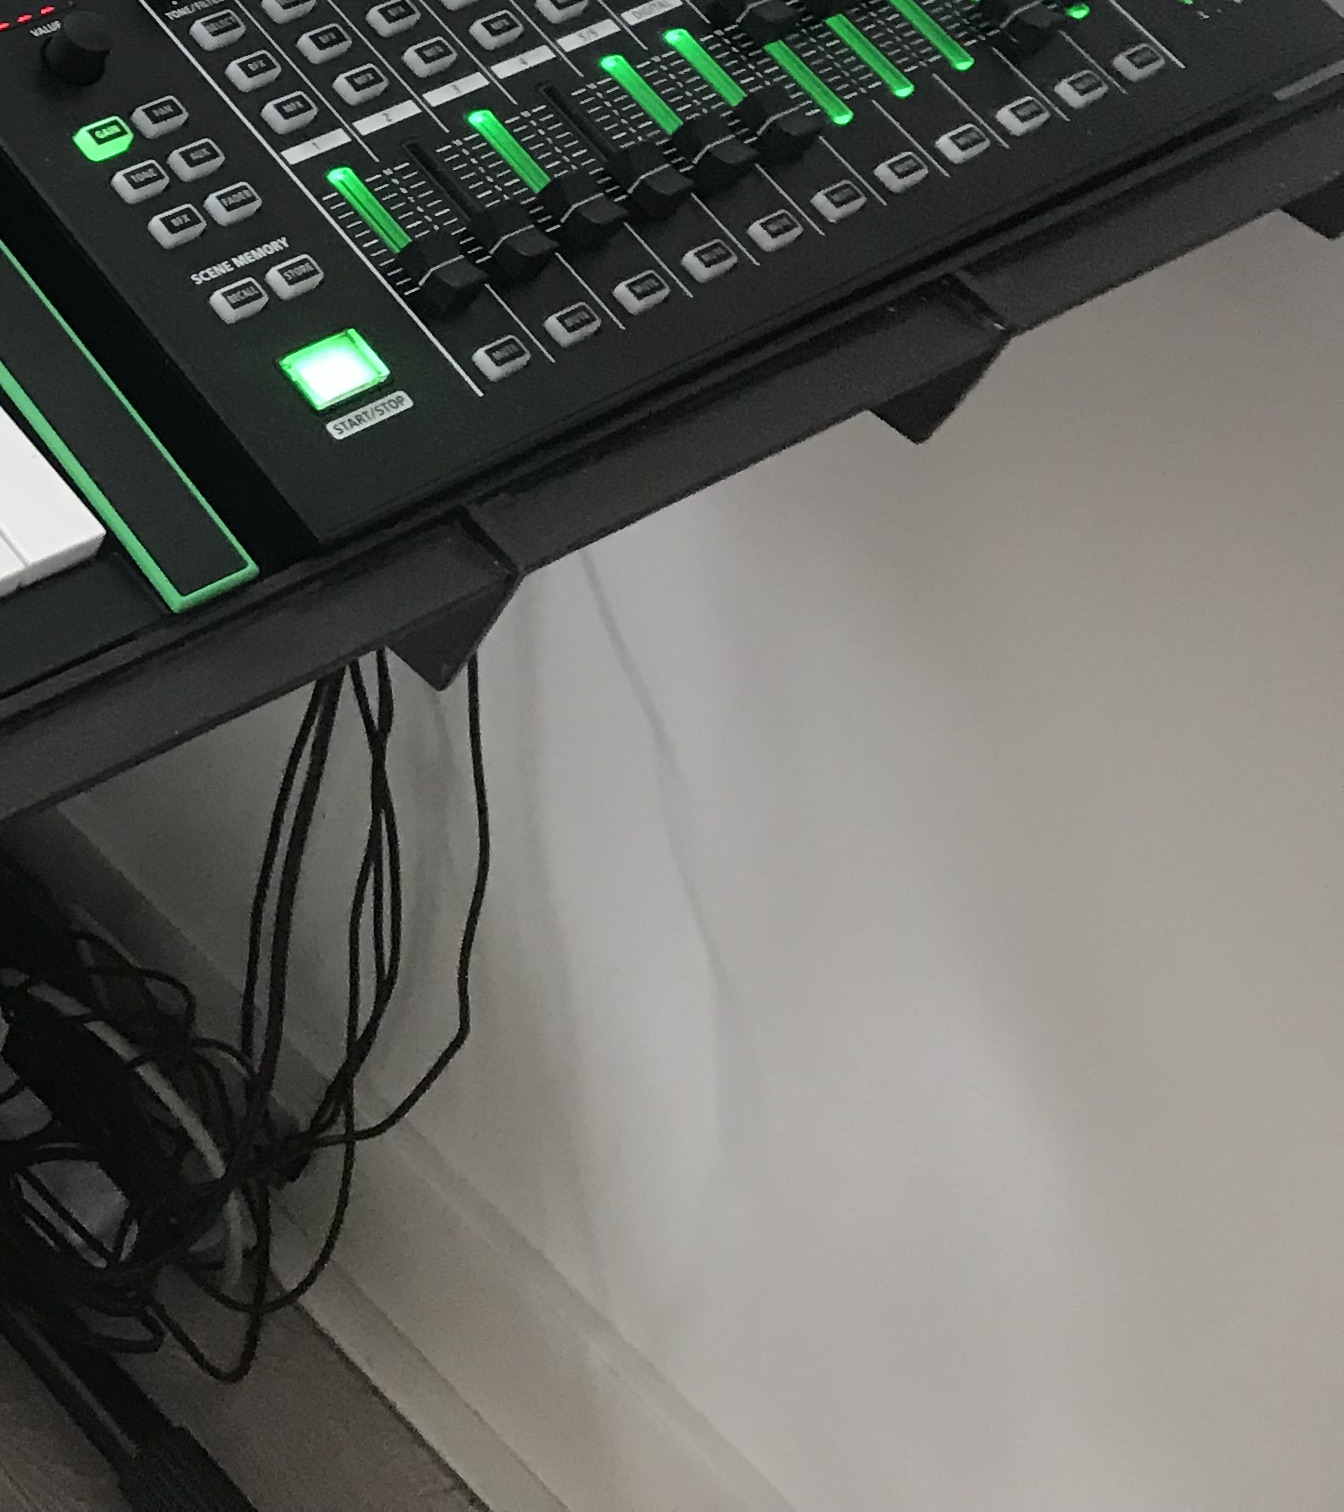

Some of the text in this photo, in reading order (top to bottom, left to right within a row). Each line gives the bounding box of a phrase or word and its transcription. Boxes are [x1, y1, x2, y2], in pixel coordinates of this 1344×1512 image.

[93, 124, 121, 140] GAIN
[130, 168, 158, 184] TONE
[220, 190, 253, 207] FADER
[190, 236, 291, 286] SCENE MEMORY
[282, 263, 314, 281] STORE
[224, 285, 260, 306] RECALL
[332, 394, 406, 437] START/STOP
